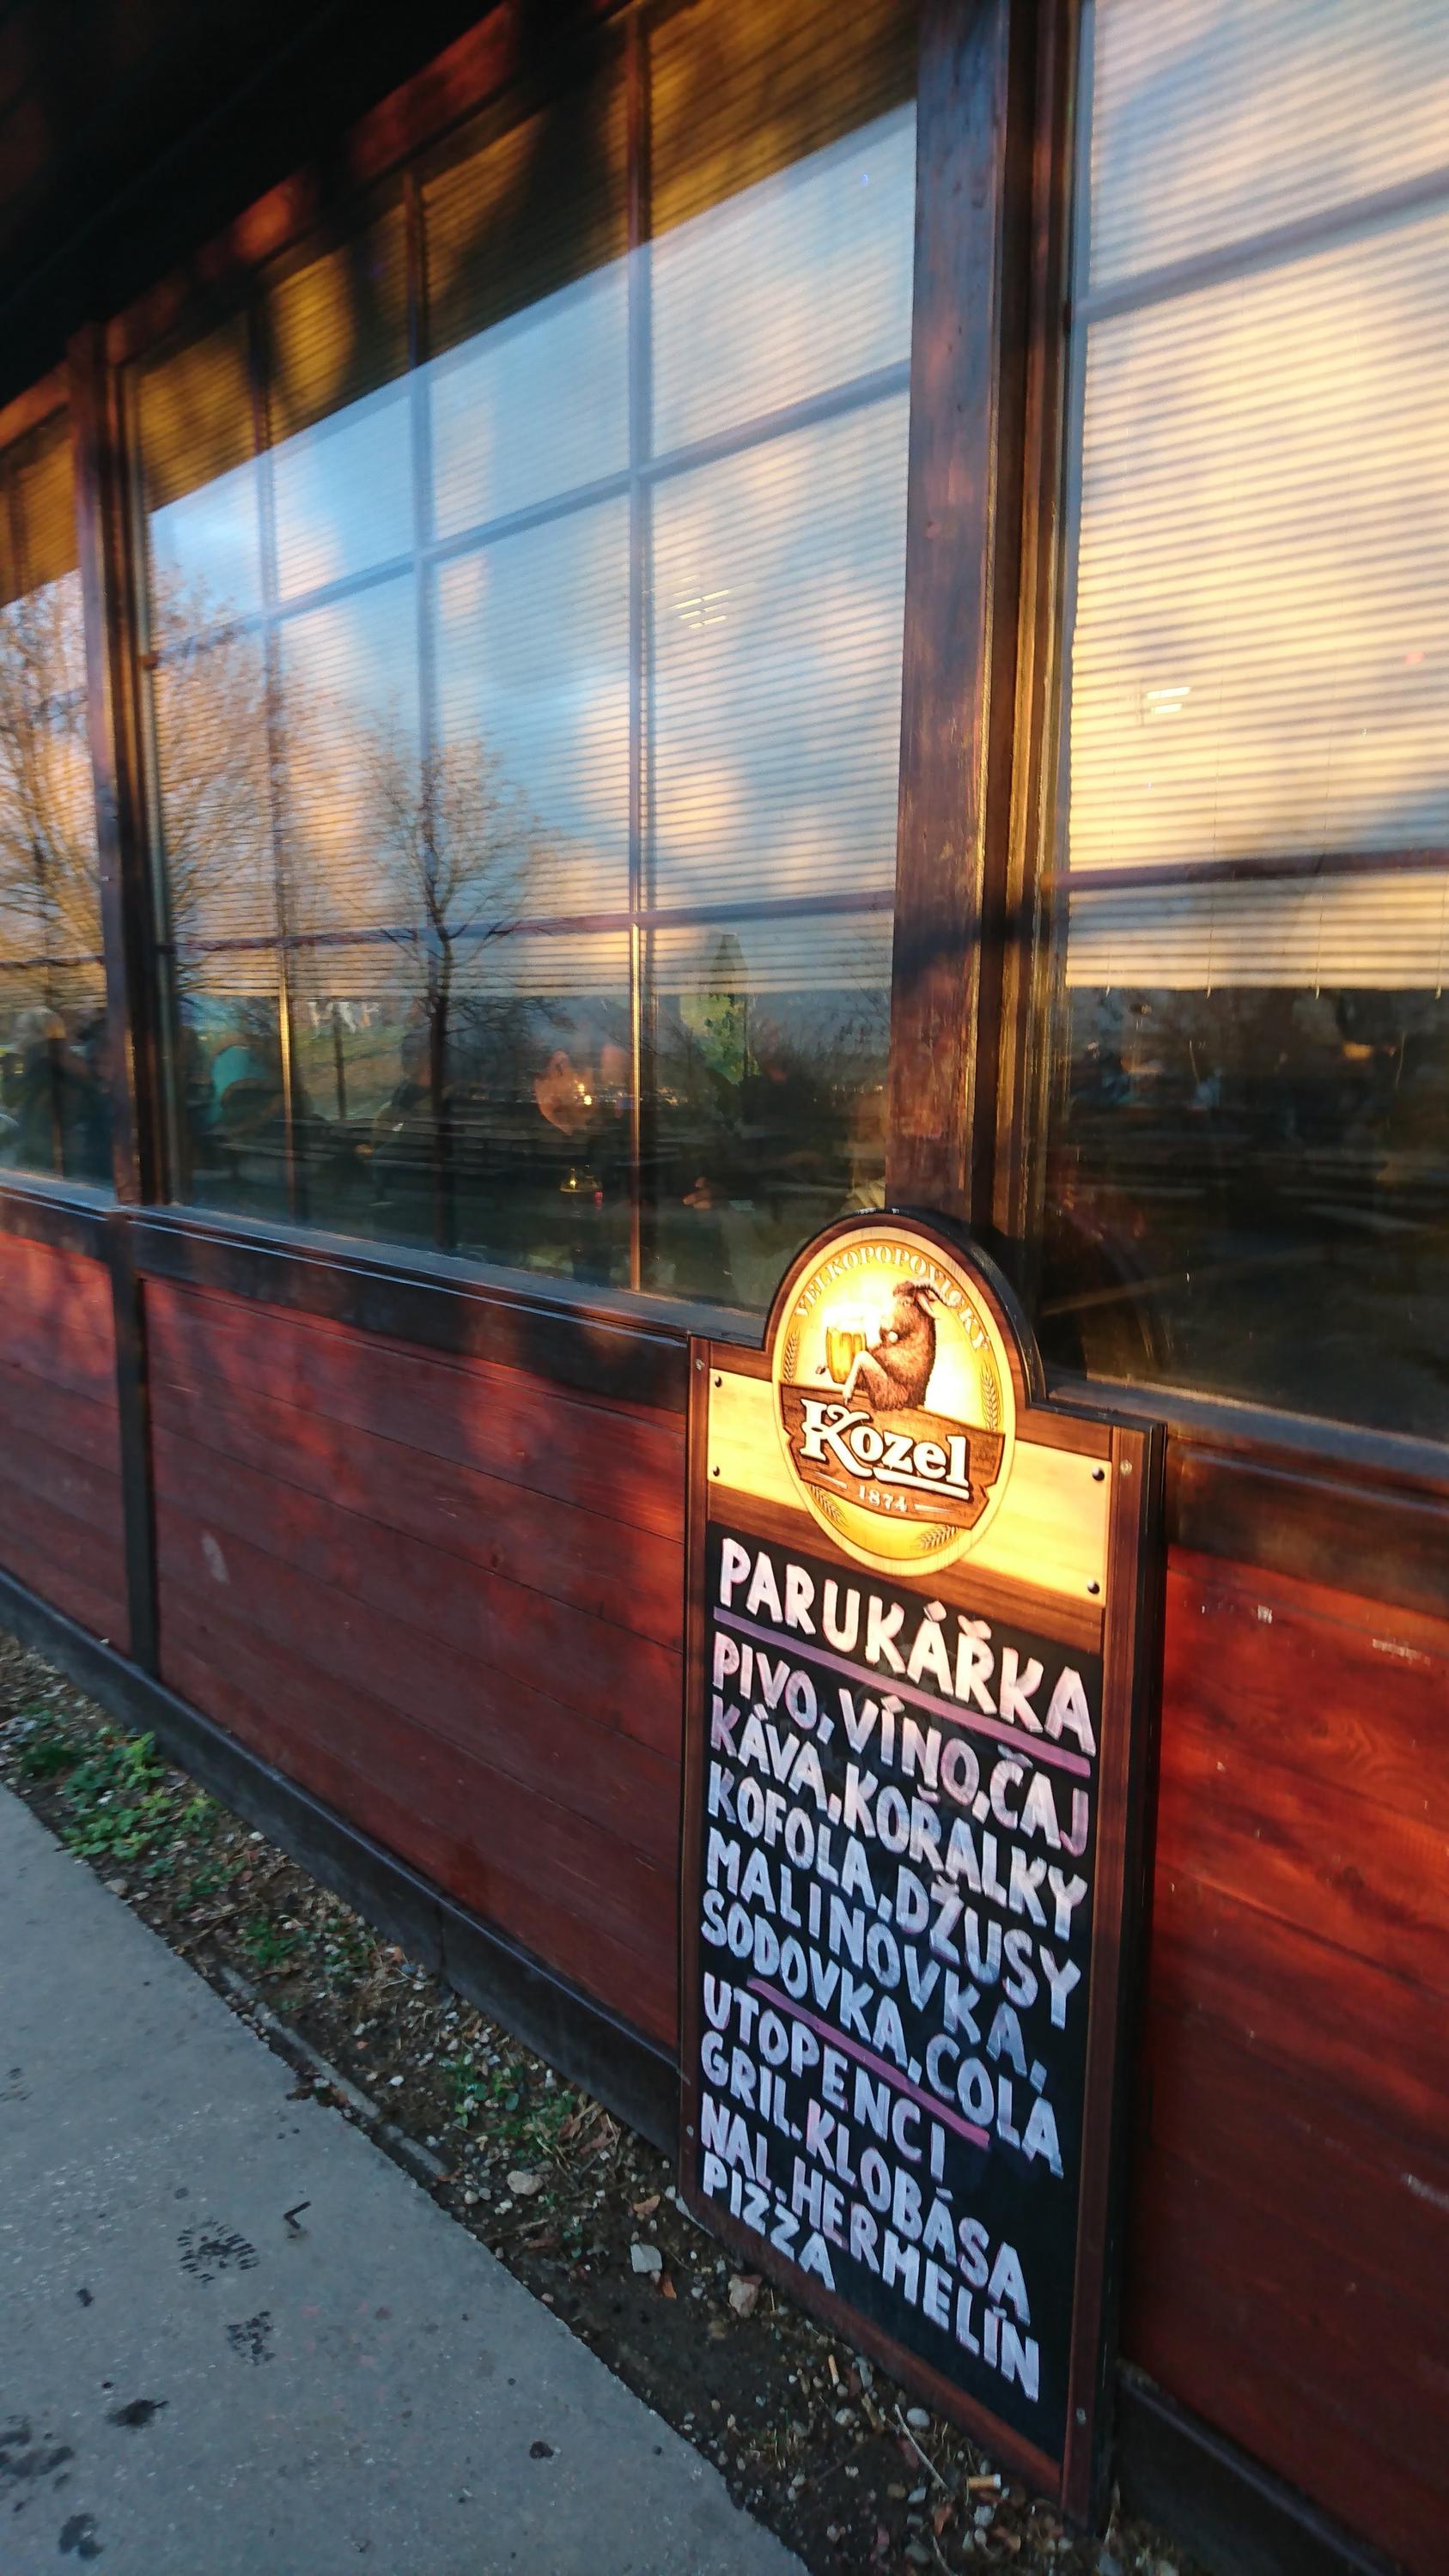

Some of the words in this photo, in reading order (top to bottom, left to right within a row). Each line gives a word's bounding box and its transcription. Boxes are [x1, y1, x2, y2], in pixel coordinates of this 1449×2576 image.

[800, 1398, 970, 1488] Kozel
[858, 1485, 908, 1513] 1874
[719, 1537, 1097, 1757] PARUKÁŘKA
[703, 1971, 946, 2185] UTOPENCI
[926, 2032, 1064, 2180] COLA
[702, 2150, 837, 2292] PIZZA
[791, 2155, 1040, 2404] HERMELÍN
[806, 2097, 1032, 2328] KLOBÁSA
